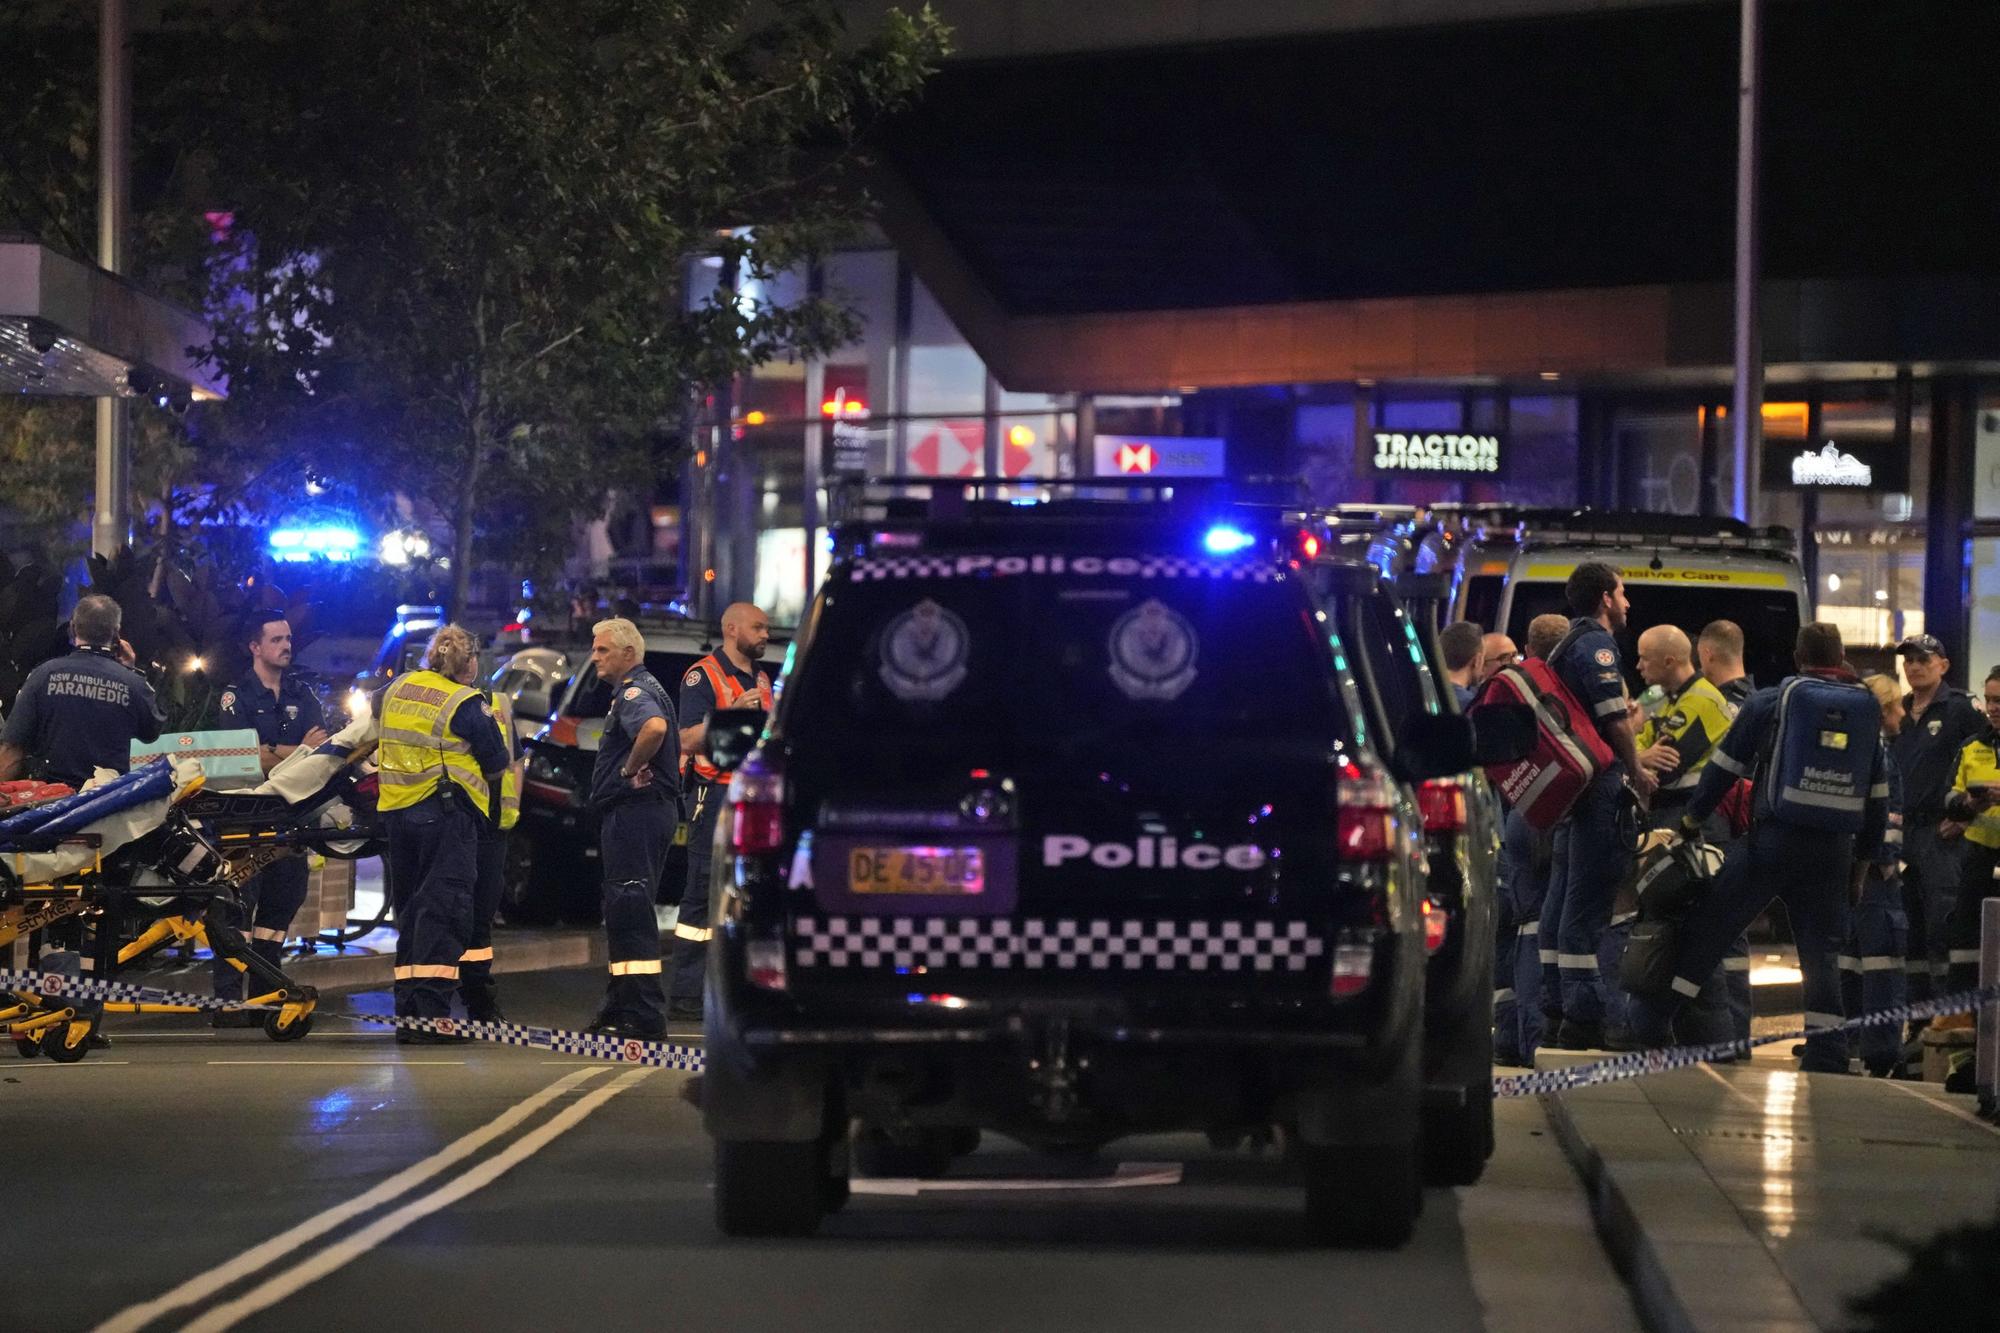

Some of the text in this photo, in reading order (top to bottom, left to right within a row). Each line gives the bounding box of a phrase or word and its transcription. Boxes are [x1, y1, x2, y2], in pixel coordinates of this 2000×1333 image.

[1373, 433, 1499, 457] TRACTON
[956, 554, 1142, 575] Police
[1621, 569, 1730, 582] nsive Care
[47, 682, 130, 706] PARAMEDIC
[49, 673, 129, 694] NSW AMBULANCE
[1502, 759, 1530, 793] Medical
[1508, 763, 1541, 802] Retrieval
[1804, 766, 1852, 783] Medical
[1800, 778, 1855, 796] Retrieval
[1043, 835, 1266, 869] Police
[17, 900, 72, 934] stryker
[565, 1037, 606, 1051] POLICE
[655, 1051, 695, 1064] POLICE
